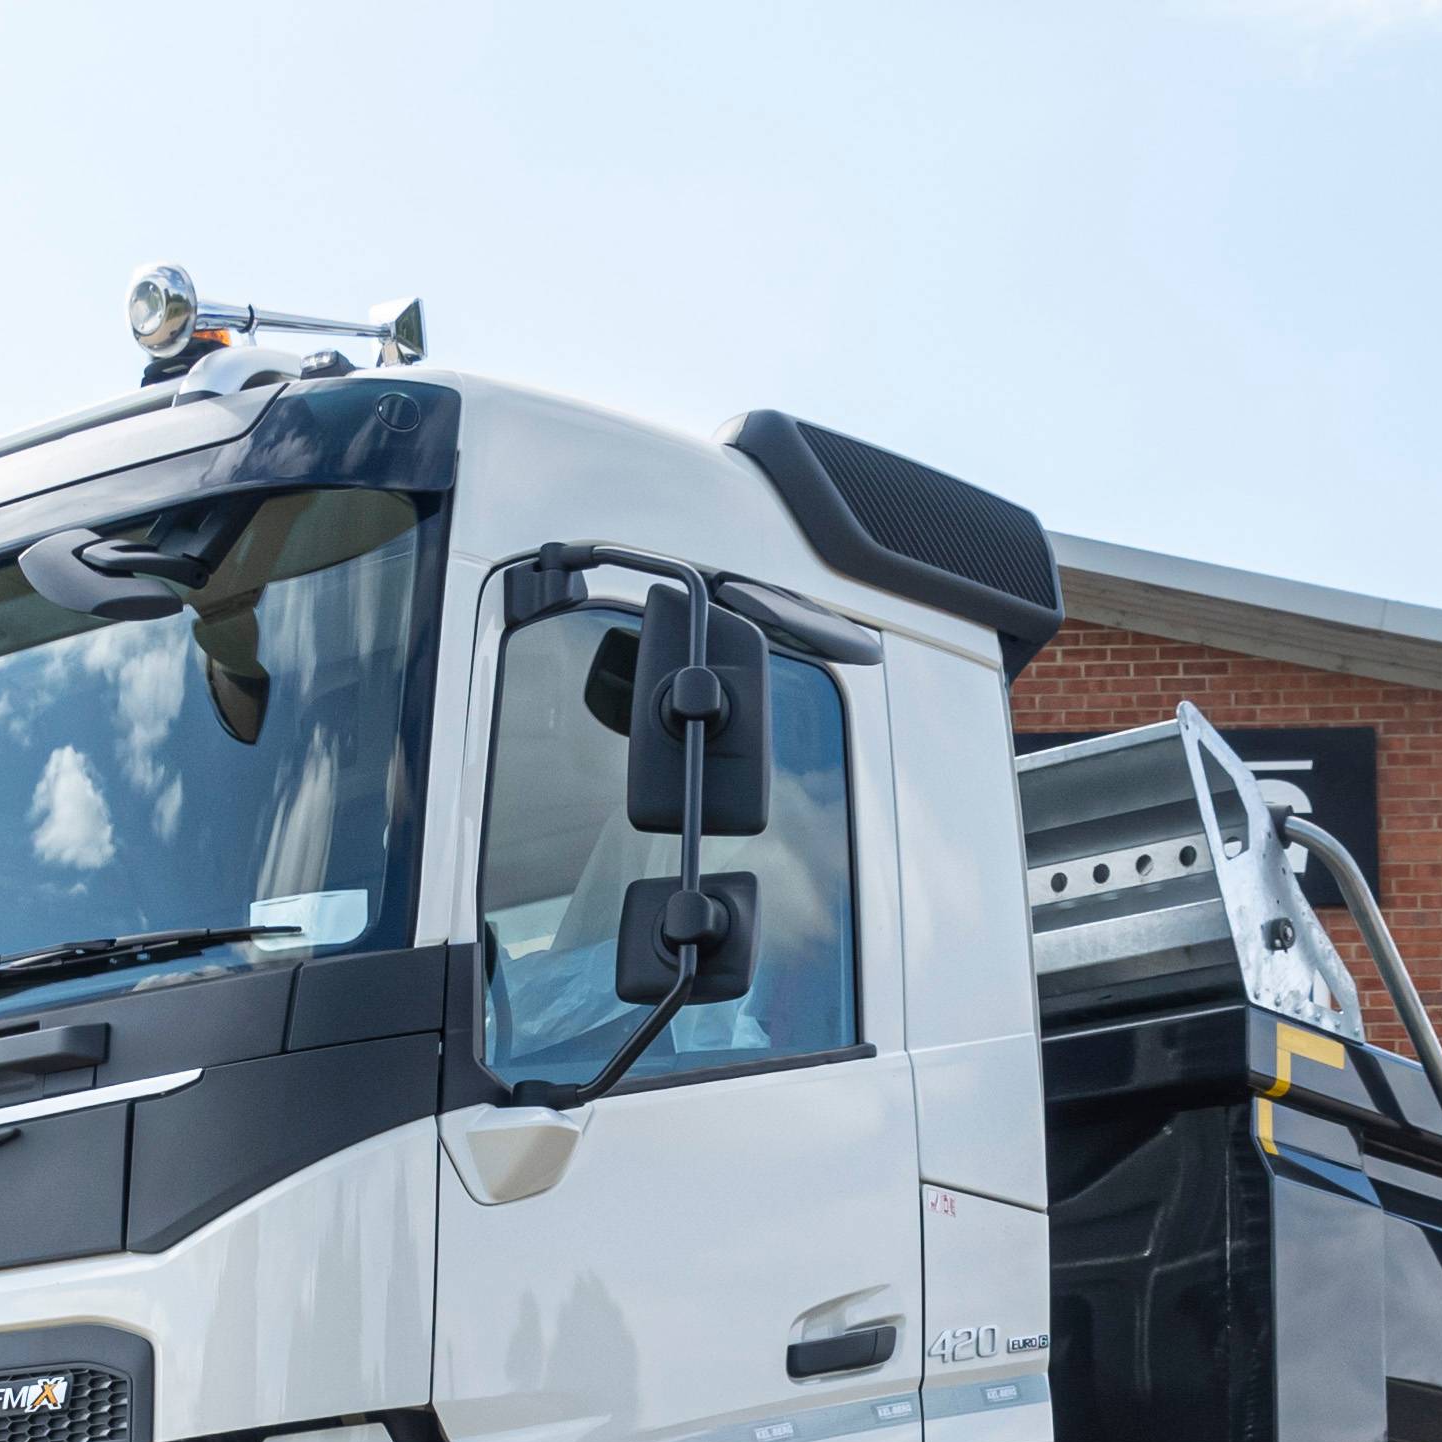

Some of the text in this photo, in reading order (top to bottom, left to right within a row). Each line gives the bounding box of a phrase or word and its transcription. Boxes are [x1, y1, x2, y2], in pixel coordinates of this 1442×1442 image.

[927, 1324, 1049, 1364] 420 EURO 6
